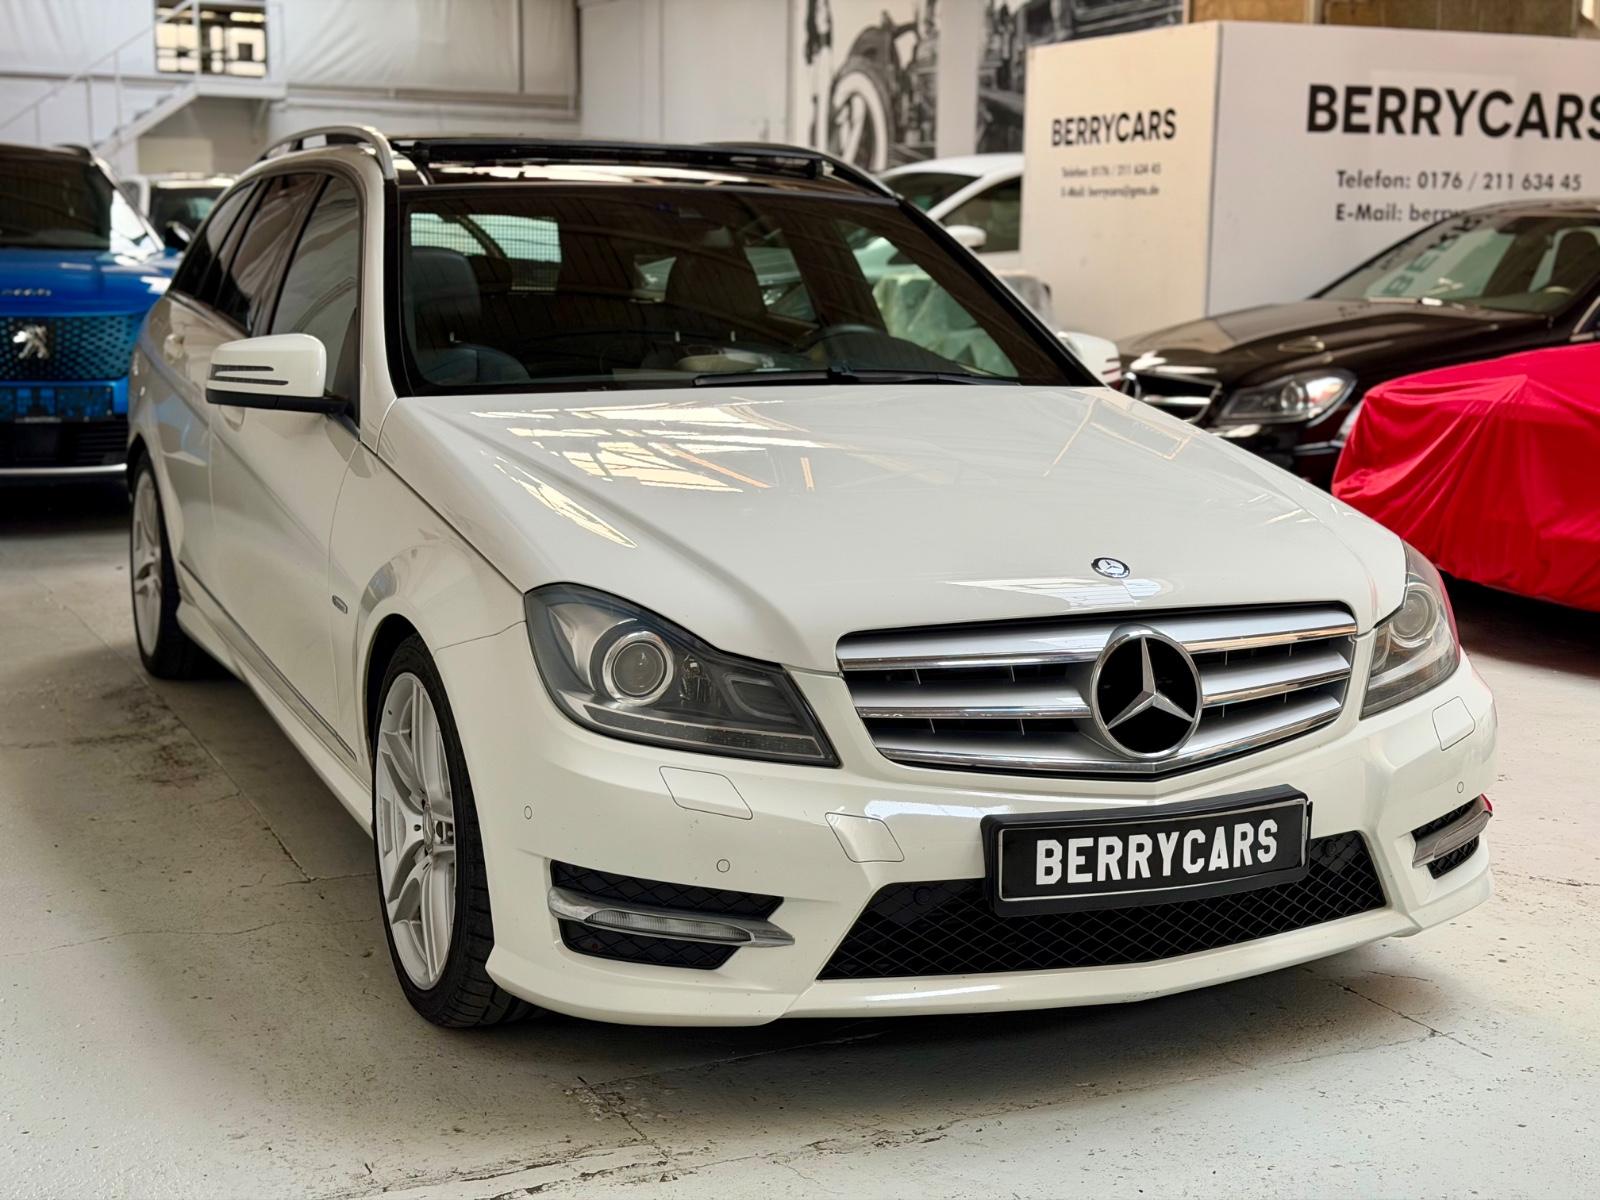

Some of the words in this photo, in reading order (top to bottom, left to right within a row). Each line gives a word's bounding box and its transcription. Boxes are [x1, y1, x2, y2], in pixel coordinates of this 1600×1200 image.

[1051, 108, 1176, 147] BERRYCARS
[1336, 169, 1410, 190] Telefon:
[1417, 171, 1463, 190] 0176
[1467, 171, 1478, 192] /
[1483, 172, 1514, 191] 211
[1521, 173, 1554, 191] 634
[1560, 173, 1582, 192] 45
[1335, 203, 1402, 221] E-Mail:
[1035, 818, 1278, 886] BERRYCARS
